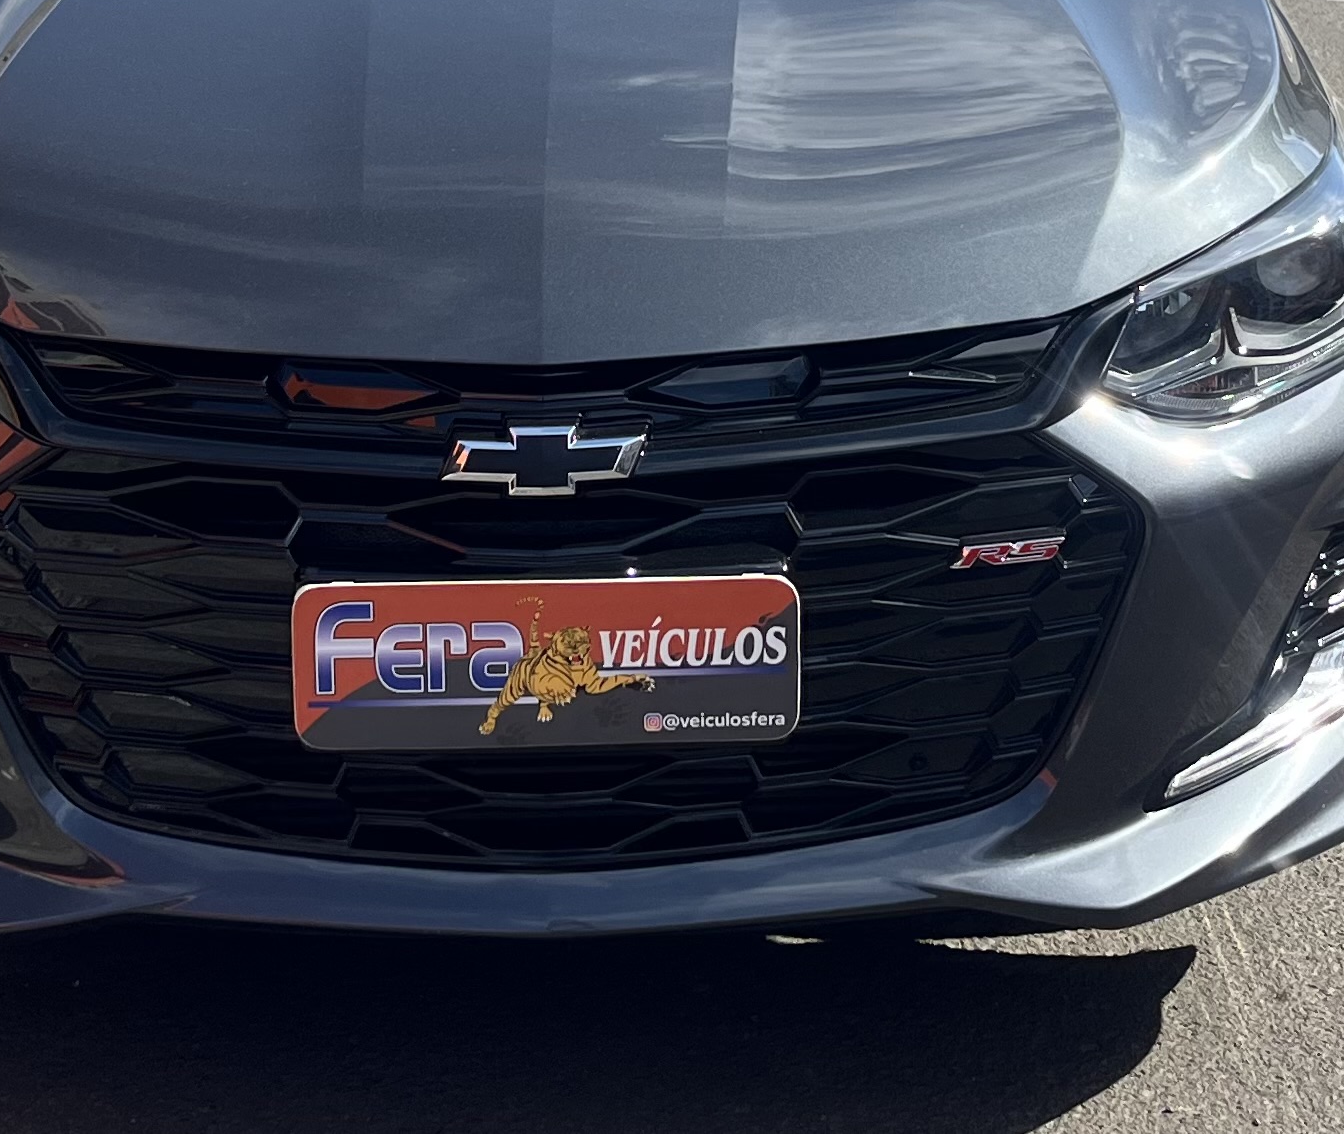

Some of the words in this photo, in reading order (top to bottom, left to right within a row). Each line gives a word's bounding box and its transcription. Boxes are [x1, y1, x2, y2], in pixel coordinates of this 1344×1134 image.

[950, 537, 1065, 569] RS
[313, 601, 524, 696] Fera
[599, 616, 787, 670] VEÍCULOS
[663, 711, 786, 732] @veiculosfera
